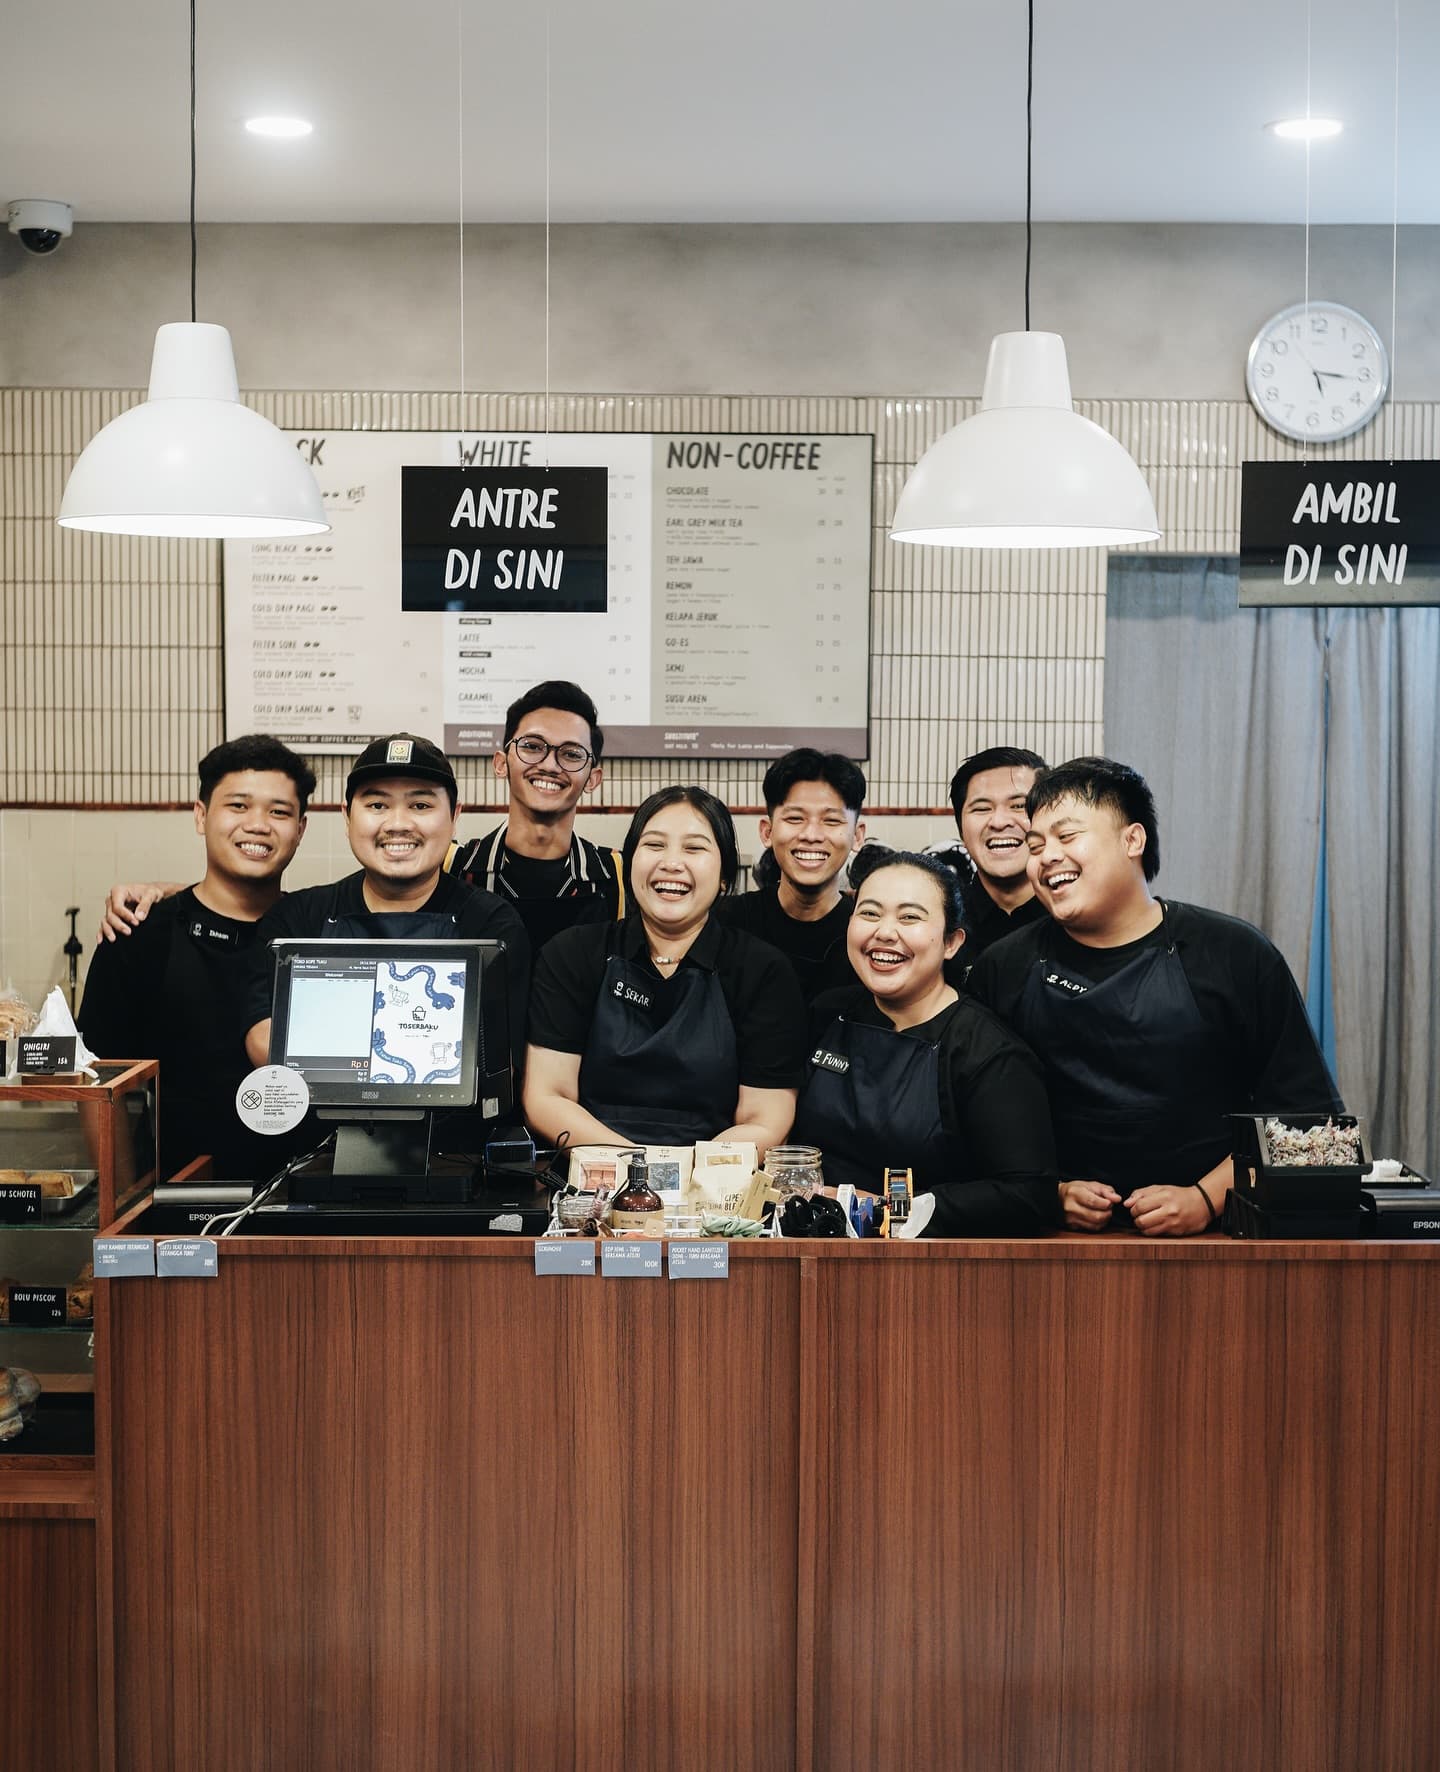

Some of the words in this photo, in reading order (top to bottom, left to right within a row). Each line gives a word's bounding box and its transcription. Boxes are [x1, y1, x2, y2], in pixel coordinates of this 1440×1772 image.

[459, 440, 532, 467] WHITE
[667, 441, 822, 470] NON-COFFEE
[666, 486, 710, 496] CHOCOLATE
[1292, 482, 1401, 524] AMBIL
[450, 488, 559, 529] ANTRE
[666, 518, 685, 528] EARL
[687, 518, 707, 528] GREY
[709, 518, 727, 528] MILK
[729, 518, 743, 528] TEA
[444, 549, 481, 590] DI
[494, 549, 564, 590] SINI
[1283, 544, 1322, 586] DI
[1334, 544, 1408, 586] SINI
[666, 581, 693, 591] REMON
[665, 612, 694, 622] KELAPA
[459, 633, 481, 643] LATTE
[459, 666, 486, 676] MOCHA
[459, 692, 493, 703] CARAMEL
[665, 695, 685, 704] SUSU
[687, 695, 708, 704] AREN
[320, 735, 345, 744] COFFEE
[624, 987, 650, 1007] SEKAR
[23, 1043, 50, 1051] ONIGIRI
[351, 1060, 362, 1069] Rp
[363, 1060, 369, 1068] 0
[822, 1053, 850, 1072] FUNNY
[9, 1190, 36, 1198] SCHOTEL
[1413, 1221, 1440, 1229] EPSON
[14, 1293, 30, 1301] BOLU
[33, 1294, 56, 1302] PISCOK
